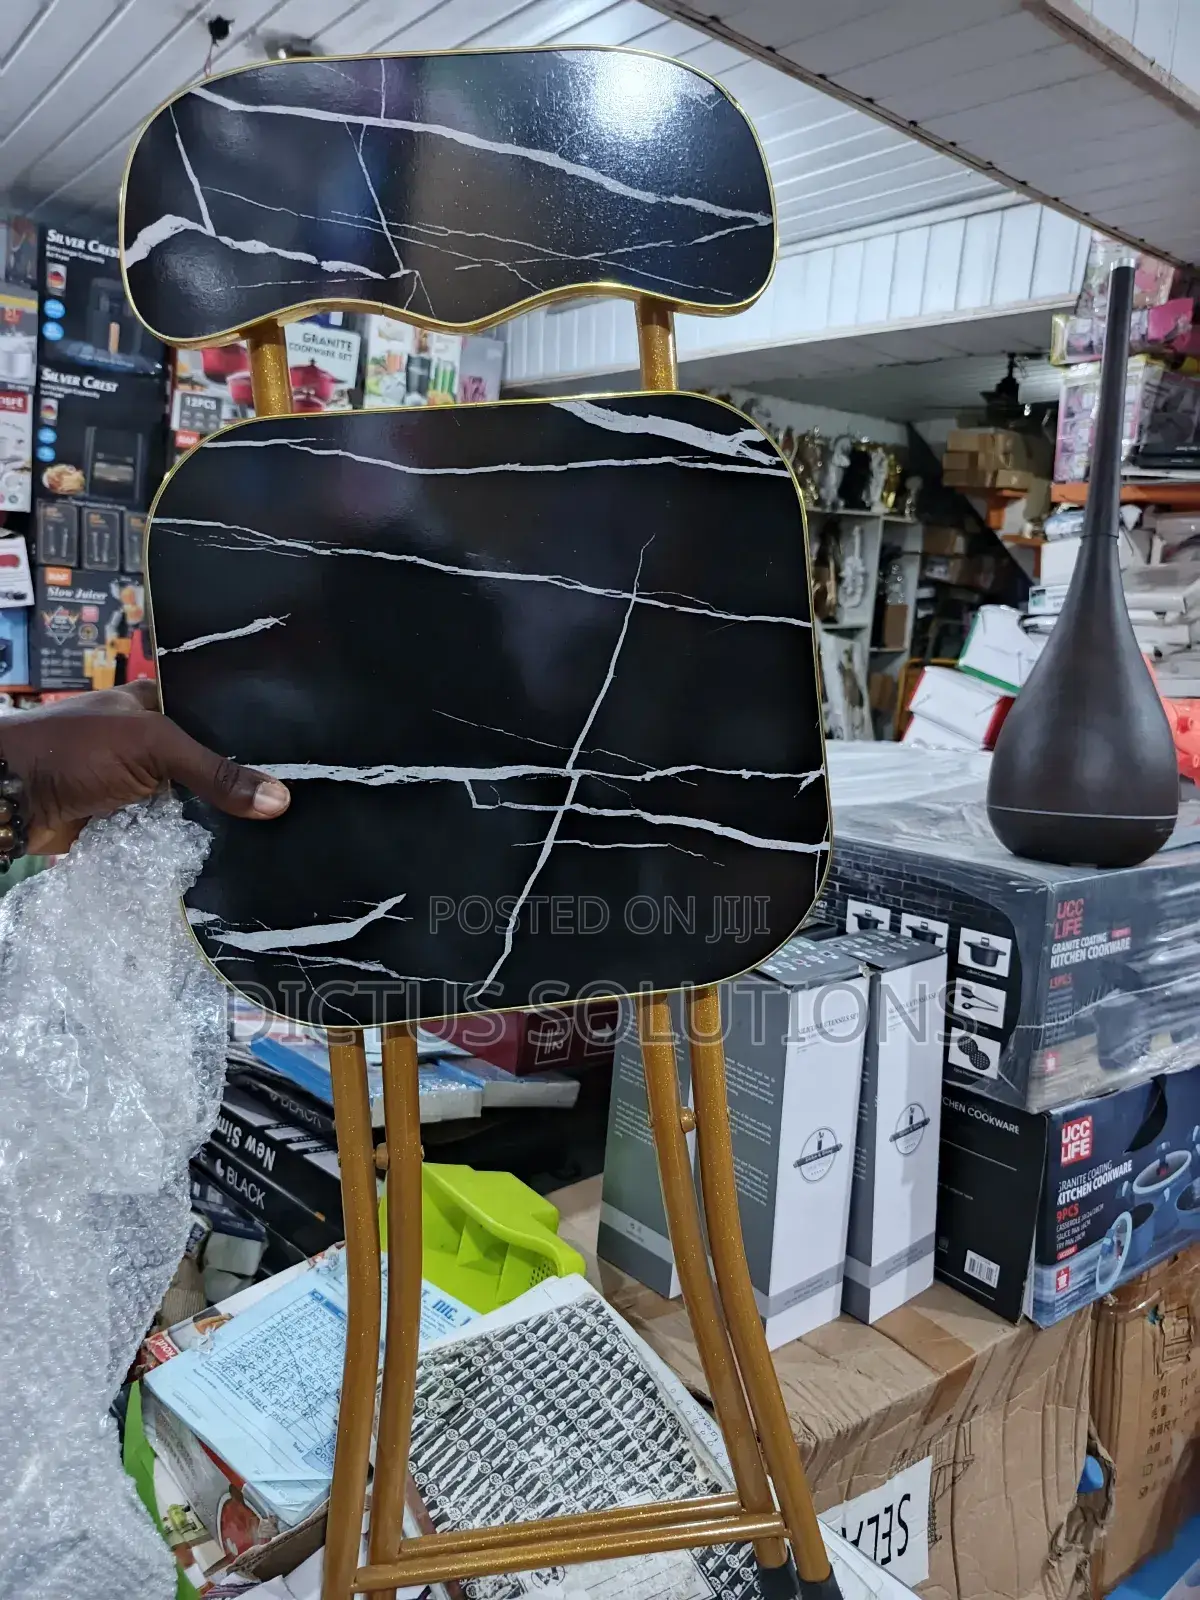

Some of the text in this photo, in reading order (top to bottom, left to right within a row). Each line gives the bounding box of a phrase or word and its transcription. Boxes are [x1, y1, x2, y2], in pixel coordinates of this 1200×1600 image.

[289, 342, 352, 362] COOKWARE SET
[303, 332, 353, 352] GRANITE
[185, 396, 217, 411] 12PCS
[47, 586, 108, 602] Slow Juicer
[1057, 898, 1084, 920] UCC
[1054, 917, 1083, 940] LIFE
[1050, 936, 1131, 969] KITCHEN COOKWARE
[1051, 938, 1080, 955] GRANITE
[1080, 932, 1108, 948] COATING
[942, 1096, 1020, 1136] CHEN COOKWARE
[1061, 1120, 1091, 1144] UCC
[245, 1135, 276, 1171] New
[1061, 1137, 1091, 1163] LIFE
[1087, 1159, 1113, 1181] COATING
[1092, 1159, 1133, 1191] COOKWARE
[226, 1165, 266, 1210] BLACK
[1056, 1203, 1079, 1223] 9PCS
